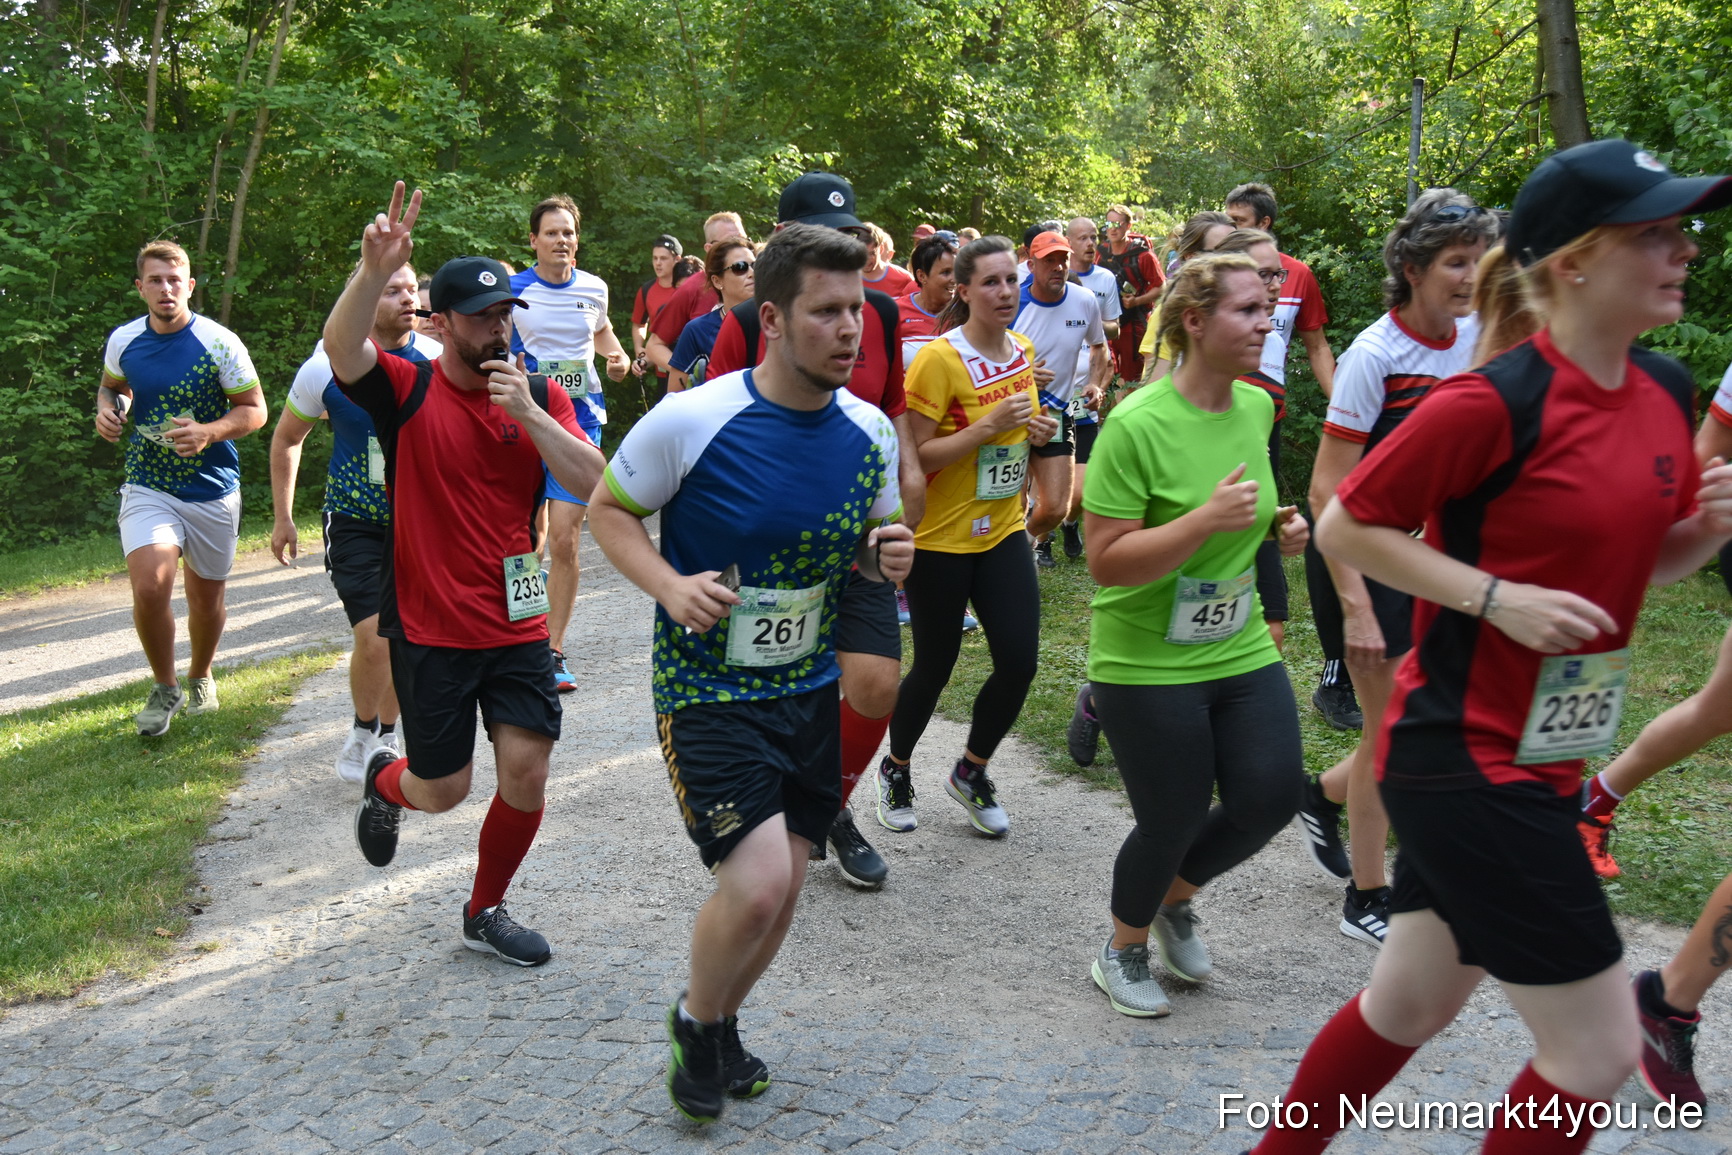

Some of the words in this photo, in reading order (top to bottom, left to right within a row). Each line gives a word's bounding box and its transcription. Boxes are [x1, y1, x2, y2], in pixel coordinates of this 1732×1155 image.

[977, 385, 1011, 407] MAX
[500, 422, 519, 440] 13
[987, 459, 1027, 485] 1592
[512, 574, 545, 602] 2332
[1191, 599, 1240, 627] 451
[751, 614, 807, 645] 261
[1537, 689, 1615, 733] 2326
